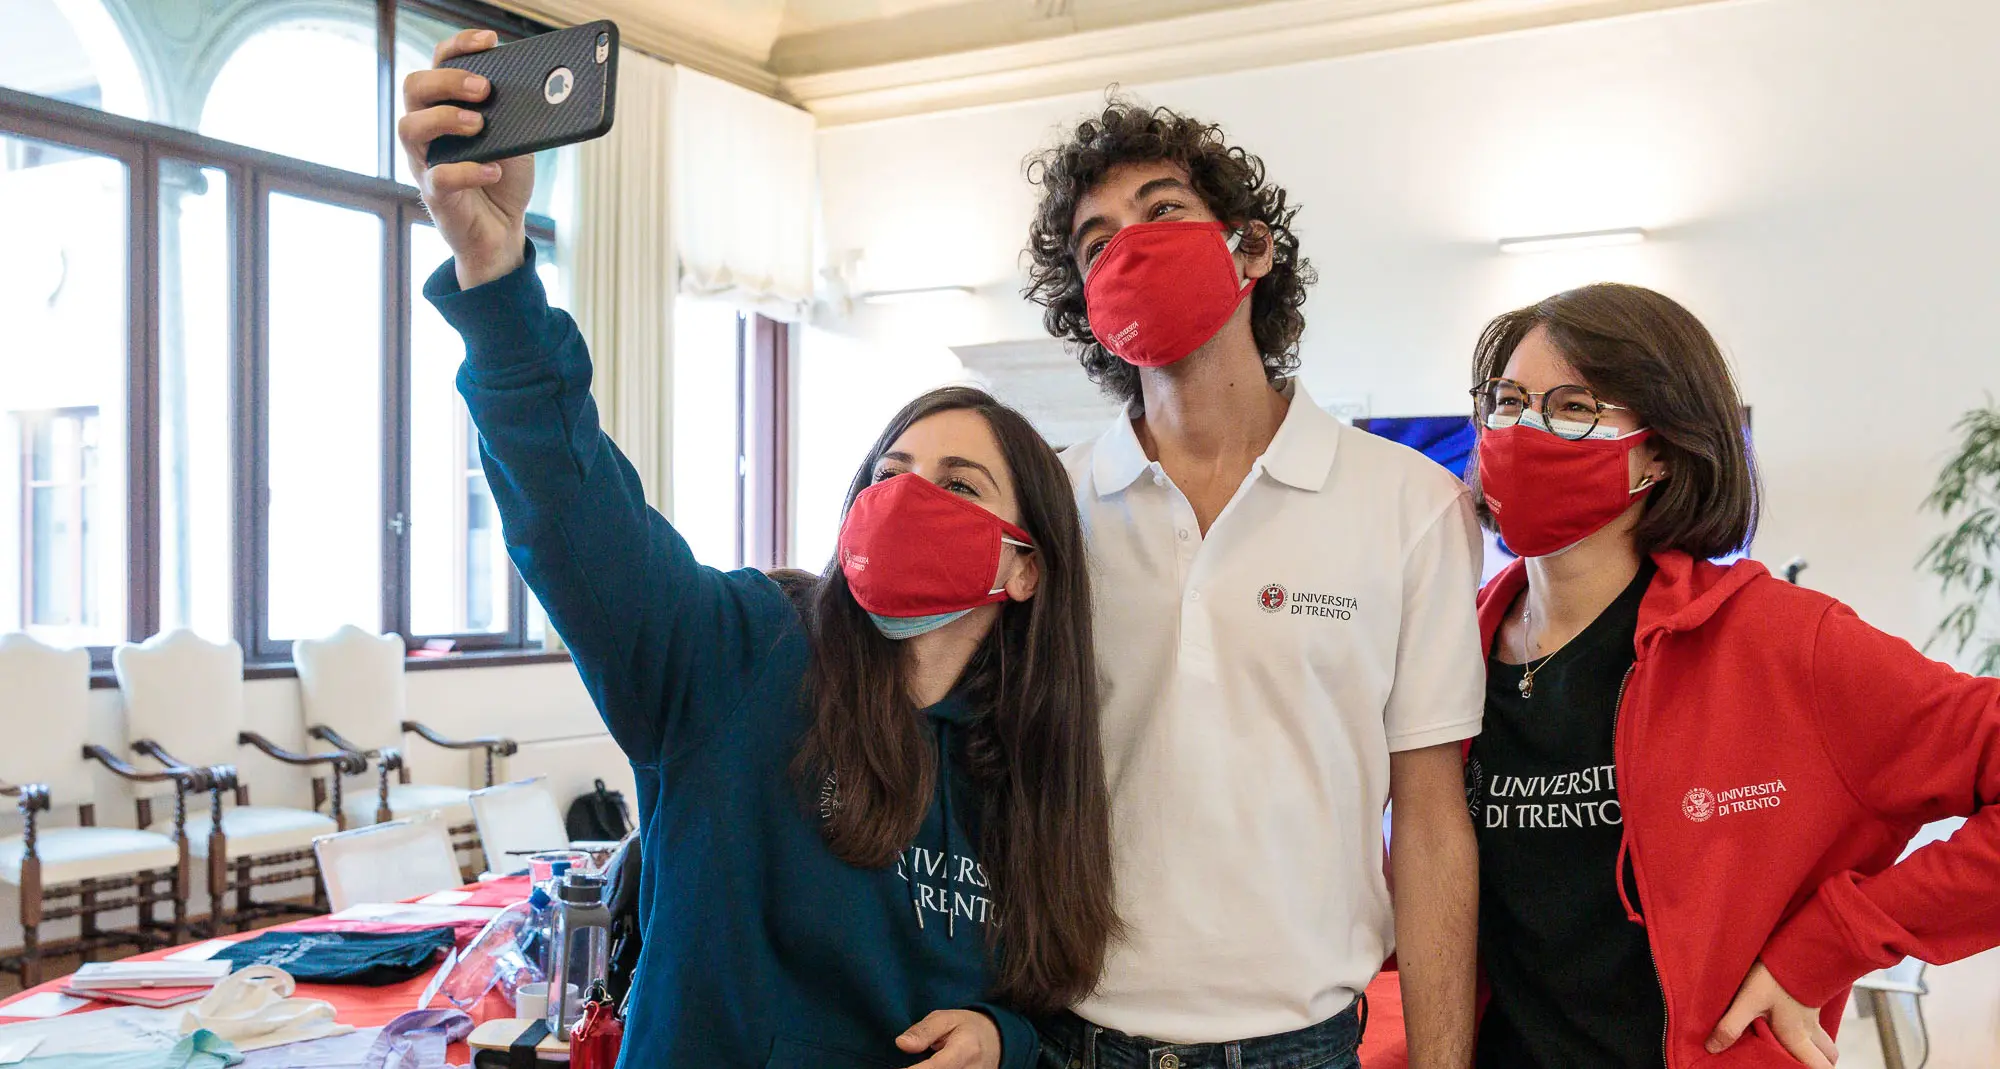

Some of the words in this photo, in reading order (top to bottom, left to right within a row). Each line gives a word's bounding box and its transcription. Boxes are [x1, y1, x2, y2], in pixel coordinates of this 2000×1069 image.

[1292, 592, 1358, 610] UNIVERSITÀ
[1291, 605, 1302, 615] DI
[1306, 605, 1351, 621] TRENTO
[1490, 765, 1616, 798] UNIVERSIT
[1717, 780, 1787, 803] UNIVERSITÀ
[1486, 804, 1508, 828] DI
[1515, 800, 1623, 828] TRENTO
[1719, 805, 1729, 816] DI
[1731, 796, 1781, 812] TRENTO
